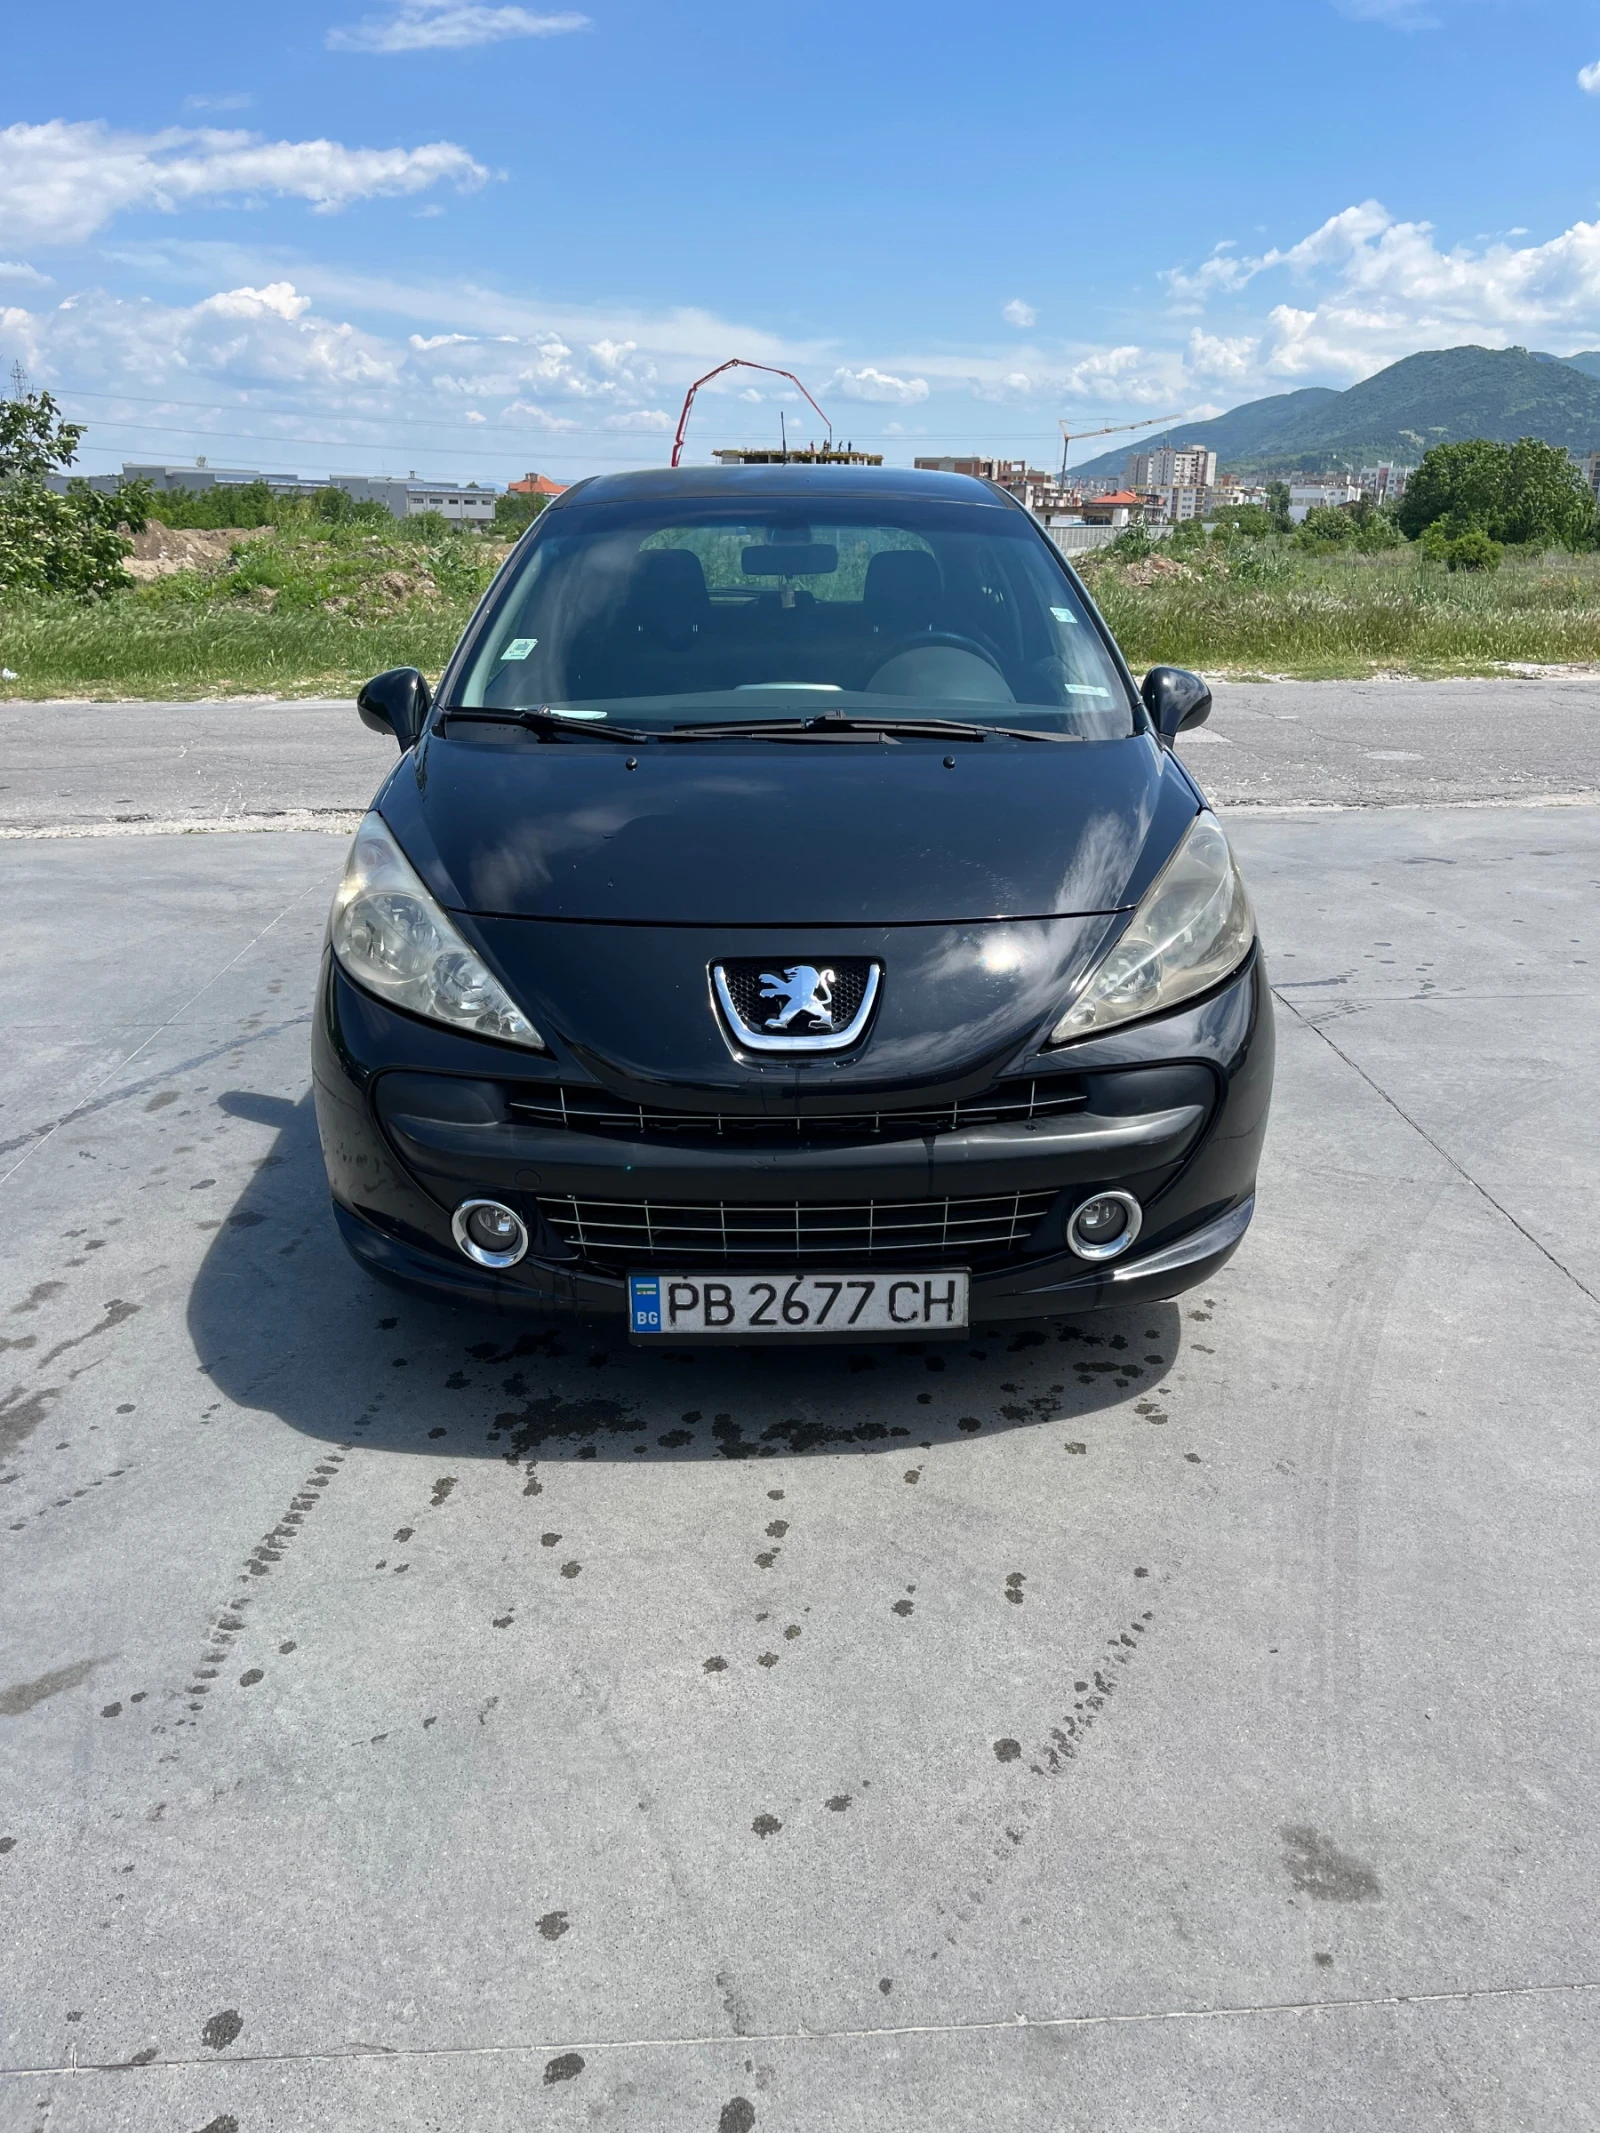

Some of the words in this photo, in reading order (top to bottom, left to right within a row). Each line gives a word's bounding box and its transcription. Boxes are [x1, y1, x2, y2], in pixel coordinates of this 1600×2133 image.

[637, 1311, 658, 1325] BG
[668, 1282, 736, 1326] PB
[749, 1281, 875, 1326] 2677
[889, 1280, 955, 1323] CH
